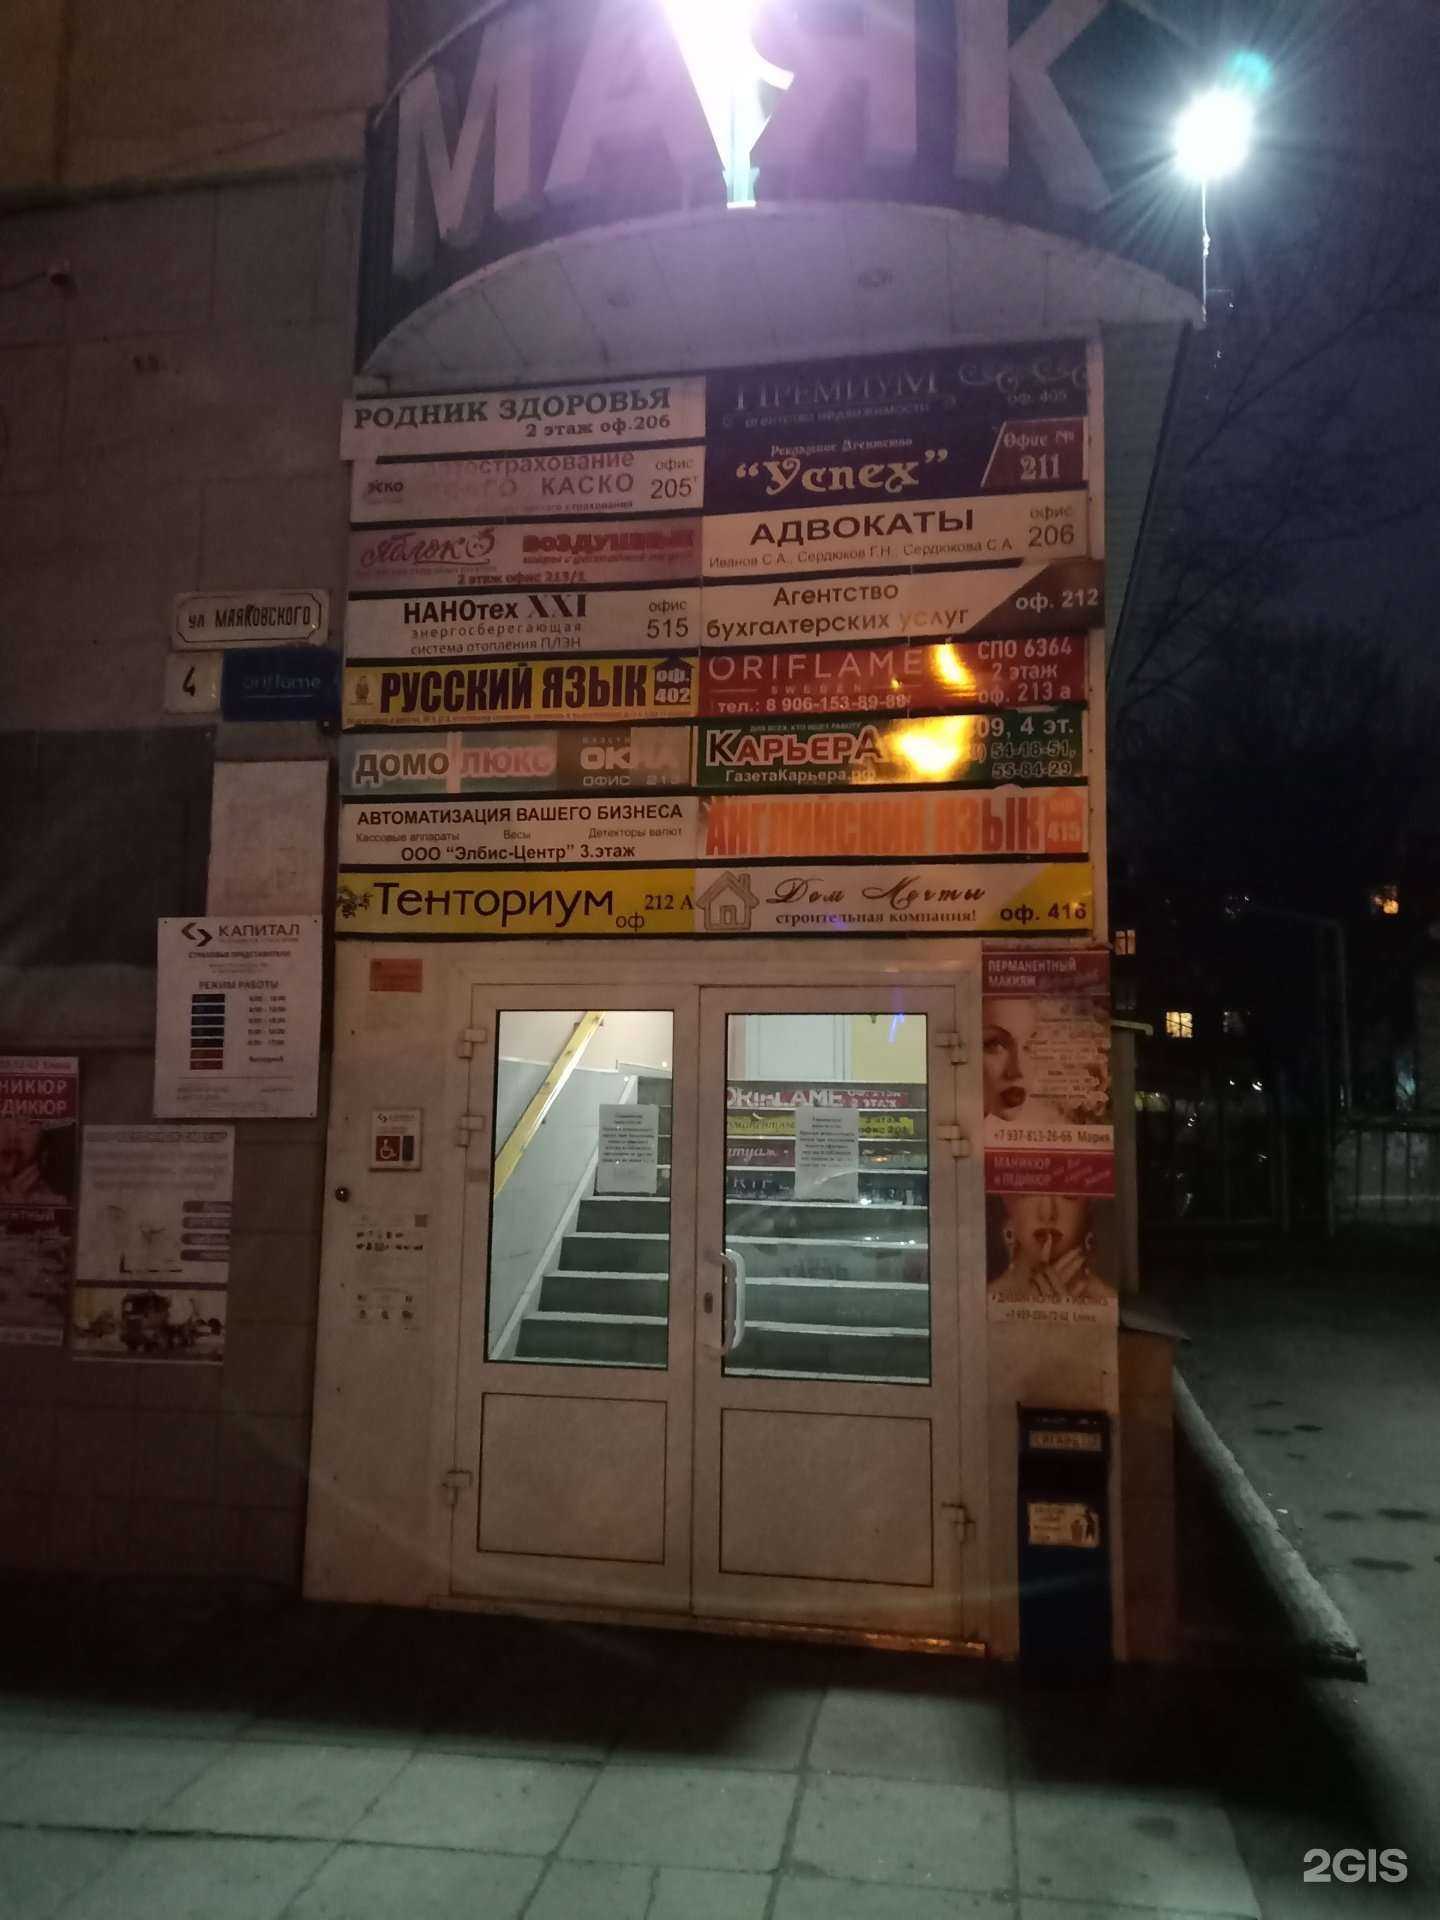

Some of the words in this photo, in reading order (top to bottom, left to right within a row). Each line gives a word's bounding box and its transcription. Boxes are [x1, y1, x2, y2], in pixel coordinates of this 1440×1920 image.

[354, 401, 489, 429] РОДНИК
[499, 387, 672, 421] ЗДОРОВЬЯ
[525, 423, 538, 437] 2
[543, 422, 593, 437] этаж
[600, 415, 671, 436] оф.206
[655, 459, 693, 472] офис
[1021, 453, 1061, 480] 211
[541, 472, 635, 496] КАСКО
[651, 478, 693, 500] 205
[750, 509, 974, 547] АДВОКАТЫ
[1030, 503, 1073, 520] офис
[1028, 524, 1075, 547] 206
[708, 556, 759, 569] Иванов
[772, 584, 900, 607] Агентство
[1015, 593, 1055, 613] оф.
[1061, 588, 1099, 607] 212
[403, 600, 519, 624] НАНОтех
[648, 599, 688, 614] офис
[410, 622, 583, 641] энергосберегающая
[646, 618, 690, 640] 515
[706, 612, 890, 641] бухгалтерских
[898, 606, 970, 632] услуг
[467, 638, 538, 652] отопления
[977, 639, 1019, 661] СПО
[1024, 637, 1073, 659] 6364
[708, 648, 923, 681] ORIFLAME
[990, 663, 1003, 680] 2
[1008, 663, 1059, 680] этаж
[380, 662, 533, 714] РУССКИЙ
[541, 664, 650, 709] ЯЗЫК
[654, 686, 692, 704] 402
[1018, 681, 1055, 701] 213
[766, 698, 777, 712] 8
[1020, 716, 1035, 736] 4
[1042, 717, 1074, 735] эт.
[357, 807, 511, 827] АВТОМАТИЗАЦИЯ
[516, 805, 592, 823] ВАШЕГО
[598, 803, 684, 820] БИЗНЕСА
[502, 829, 532, 841] Весы
[400, 846, 441, 862] ООО
[579, 844, 636, 860] 3.этаж
[644, 893, 675, 911] 212
[765, 876, 846, 905] Дом
[862, 874, 987, 910] Мечты
[373, 882, 615, 928] Тенториум
[999, 904, 1041, 924] оф.
[615, 911, 646, 931] оф
[775, 910, 885, 928] строительная
[888, 908, 978, 924] компания!
[218, 923, 301, 938] КАПИТАЛ
